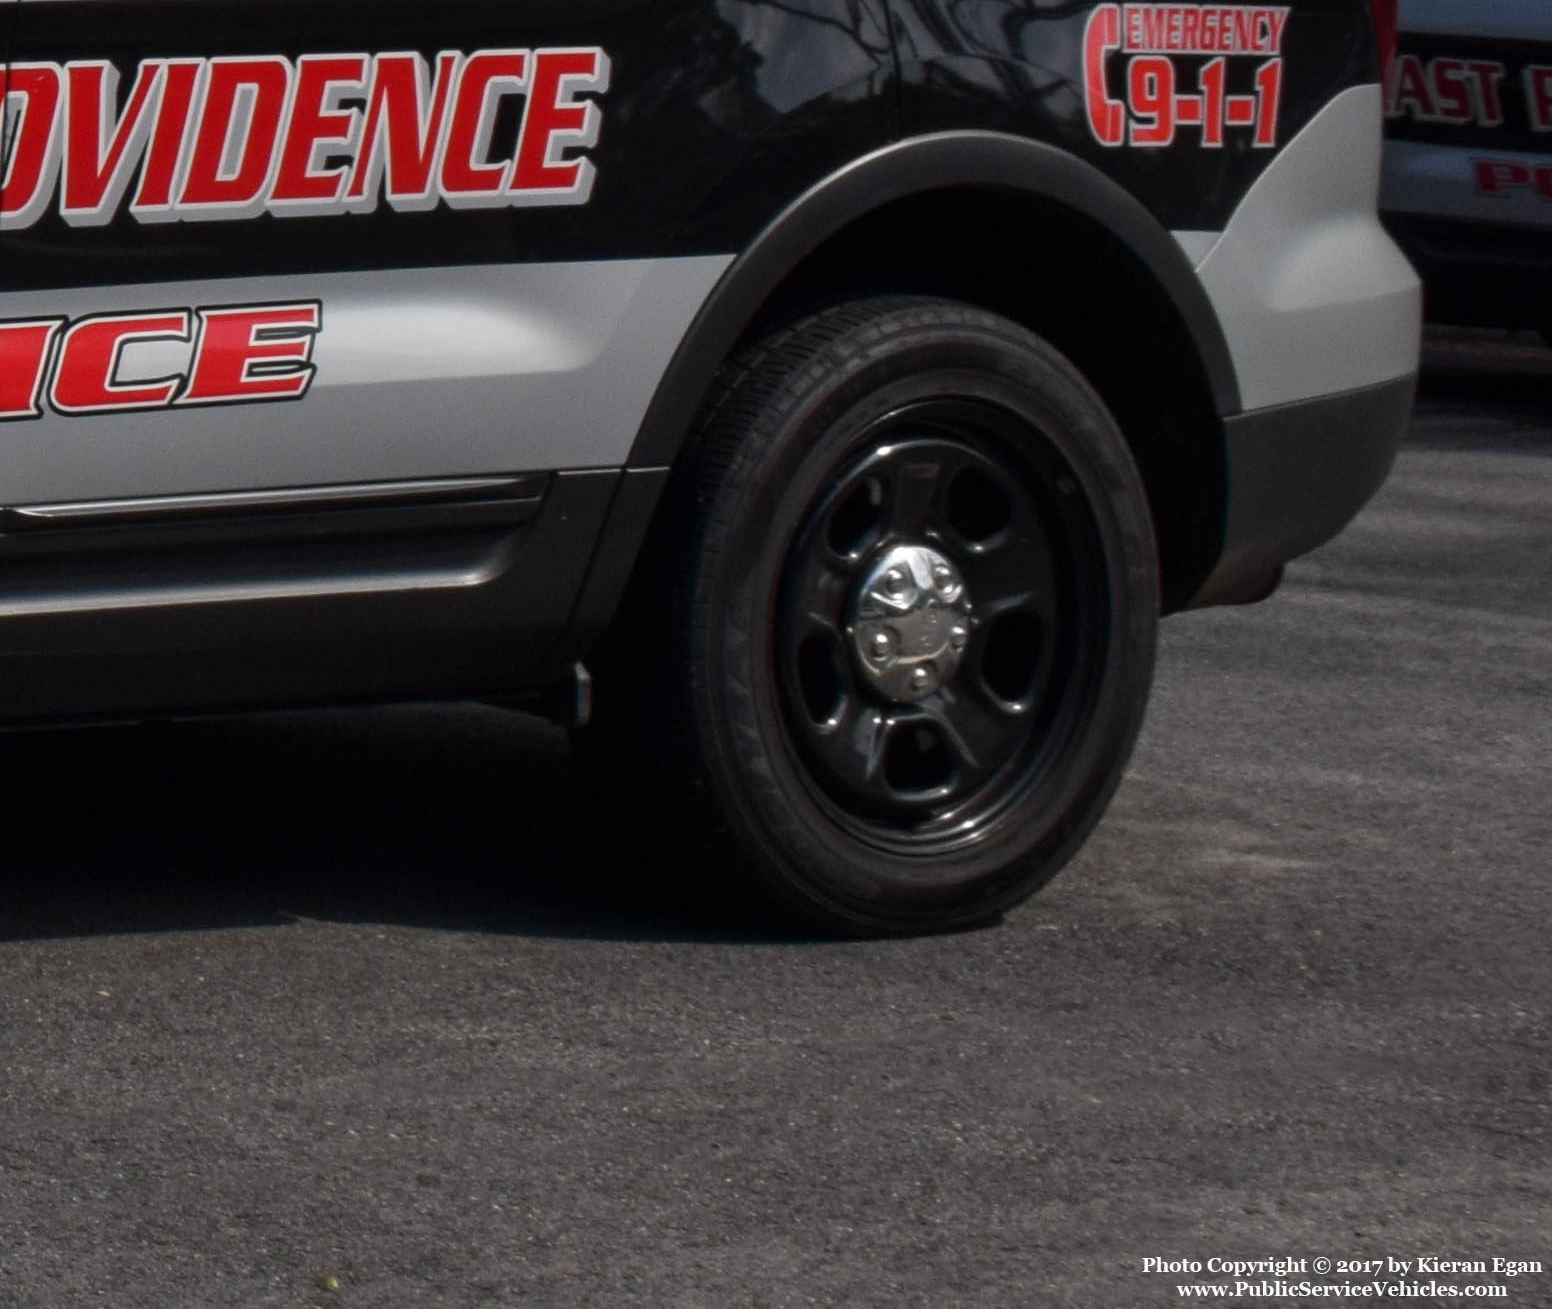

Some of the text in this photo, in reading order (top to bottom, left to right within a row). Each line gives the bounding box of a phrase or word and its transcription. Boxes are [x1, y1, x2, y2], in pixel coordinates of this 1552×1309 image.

[1122, 3, 1292, 56] EMERGENCY
[1126, 55, 1283, 148] 9-1-1
[1383, 54, 1507, 128] AST
